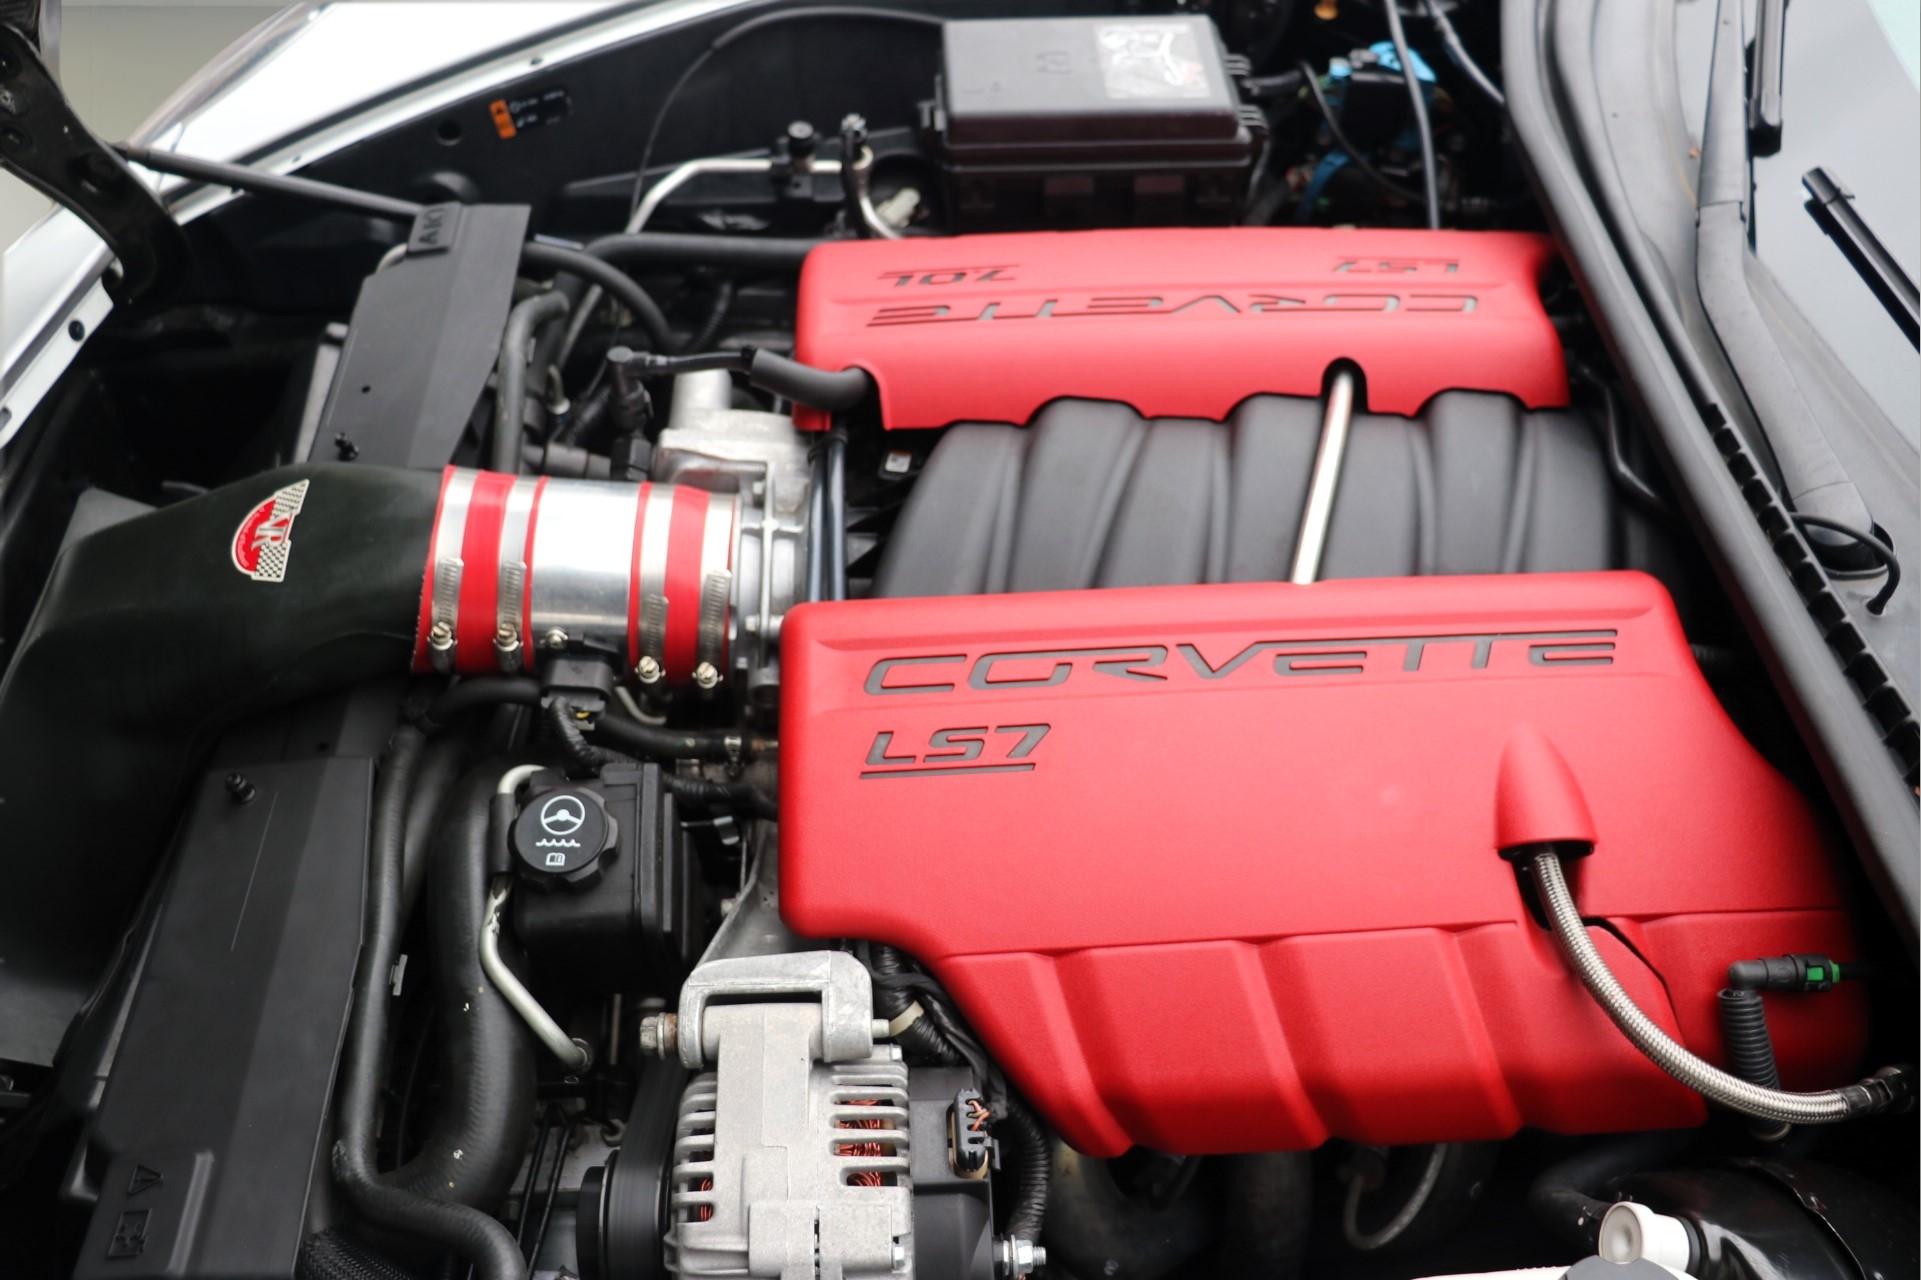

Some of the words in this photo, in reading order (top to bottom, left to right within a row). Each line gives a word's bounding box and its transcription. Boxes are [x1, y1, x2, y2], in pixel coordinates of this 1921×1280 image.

[1332, 258, 1460, 275] LS7
[866, 294, 1478, 328] CORVETTE
[863, 628, 1619, 696] CORVETTE
[864, 722, 1053, 767] LS7
